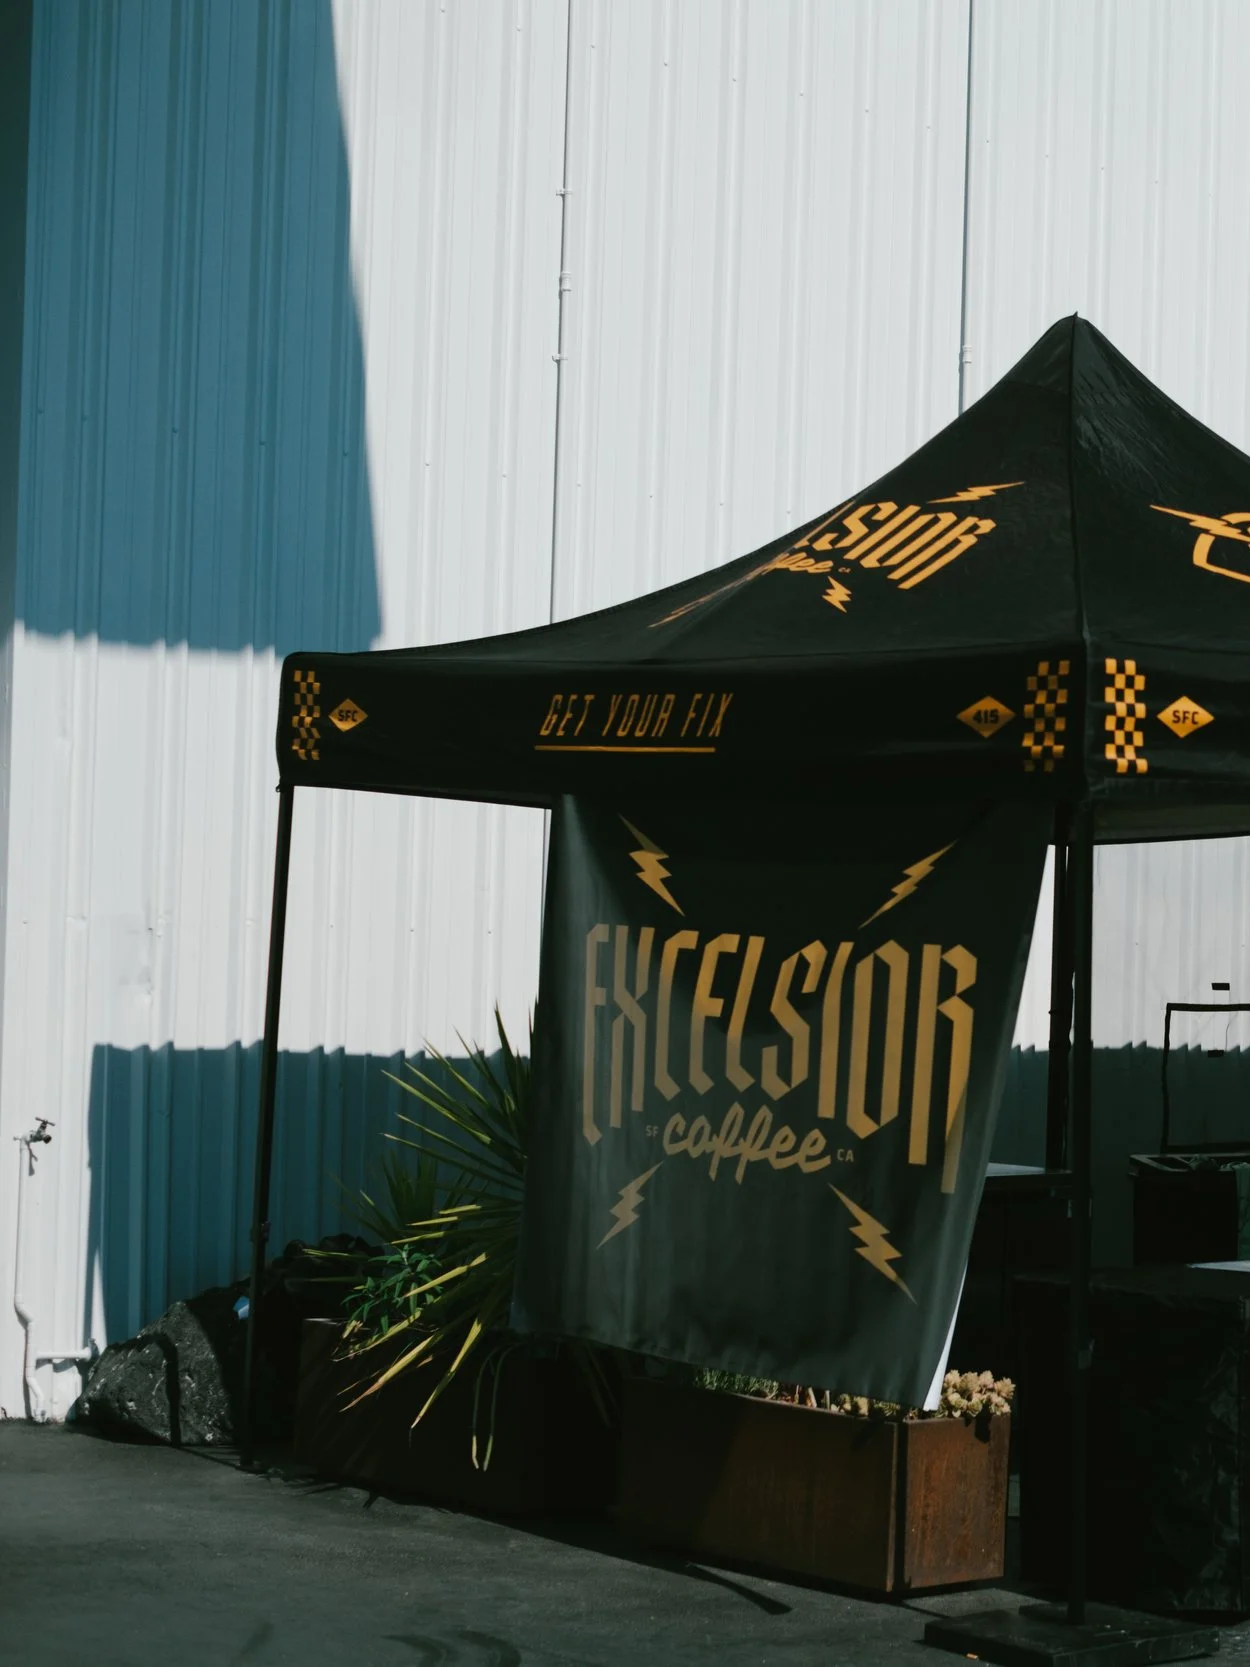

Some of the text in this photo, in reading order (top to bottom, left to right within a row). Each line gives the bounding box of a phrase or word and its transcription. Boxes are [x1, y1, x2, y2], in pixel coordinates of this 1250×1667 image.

[338, 709, 358, 722] SFC
[539, 693, 734, 737] GET YOUR FIX
[971, 708, 999, 724] 415
[1171, 710, 1200, 726] SFC
[582, 923, 978, 1194] EXCELSIOR
[645, 1102, 855, 1185] SF coffee CA
